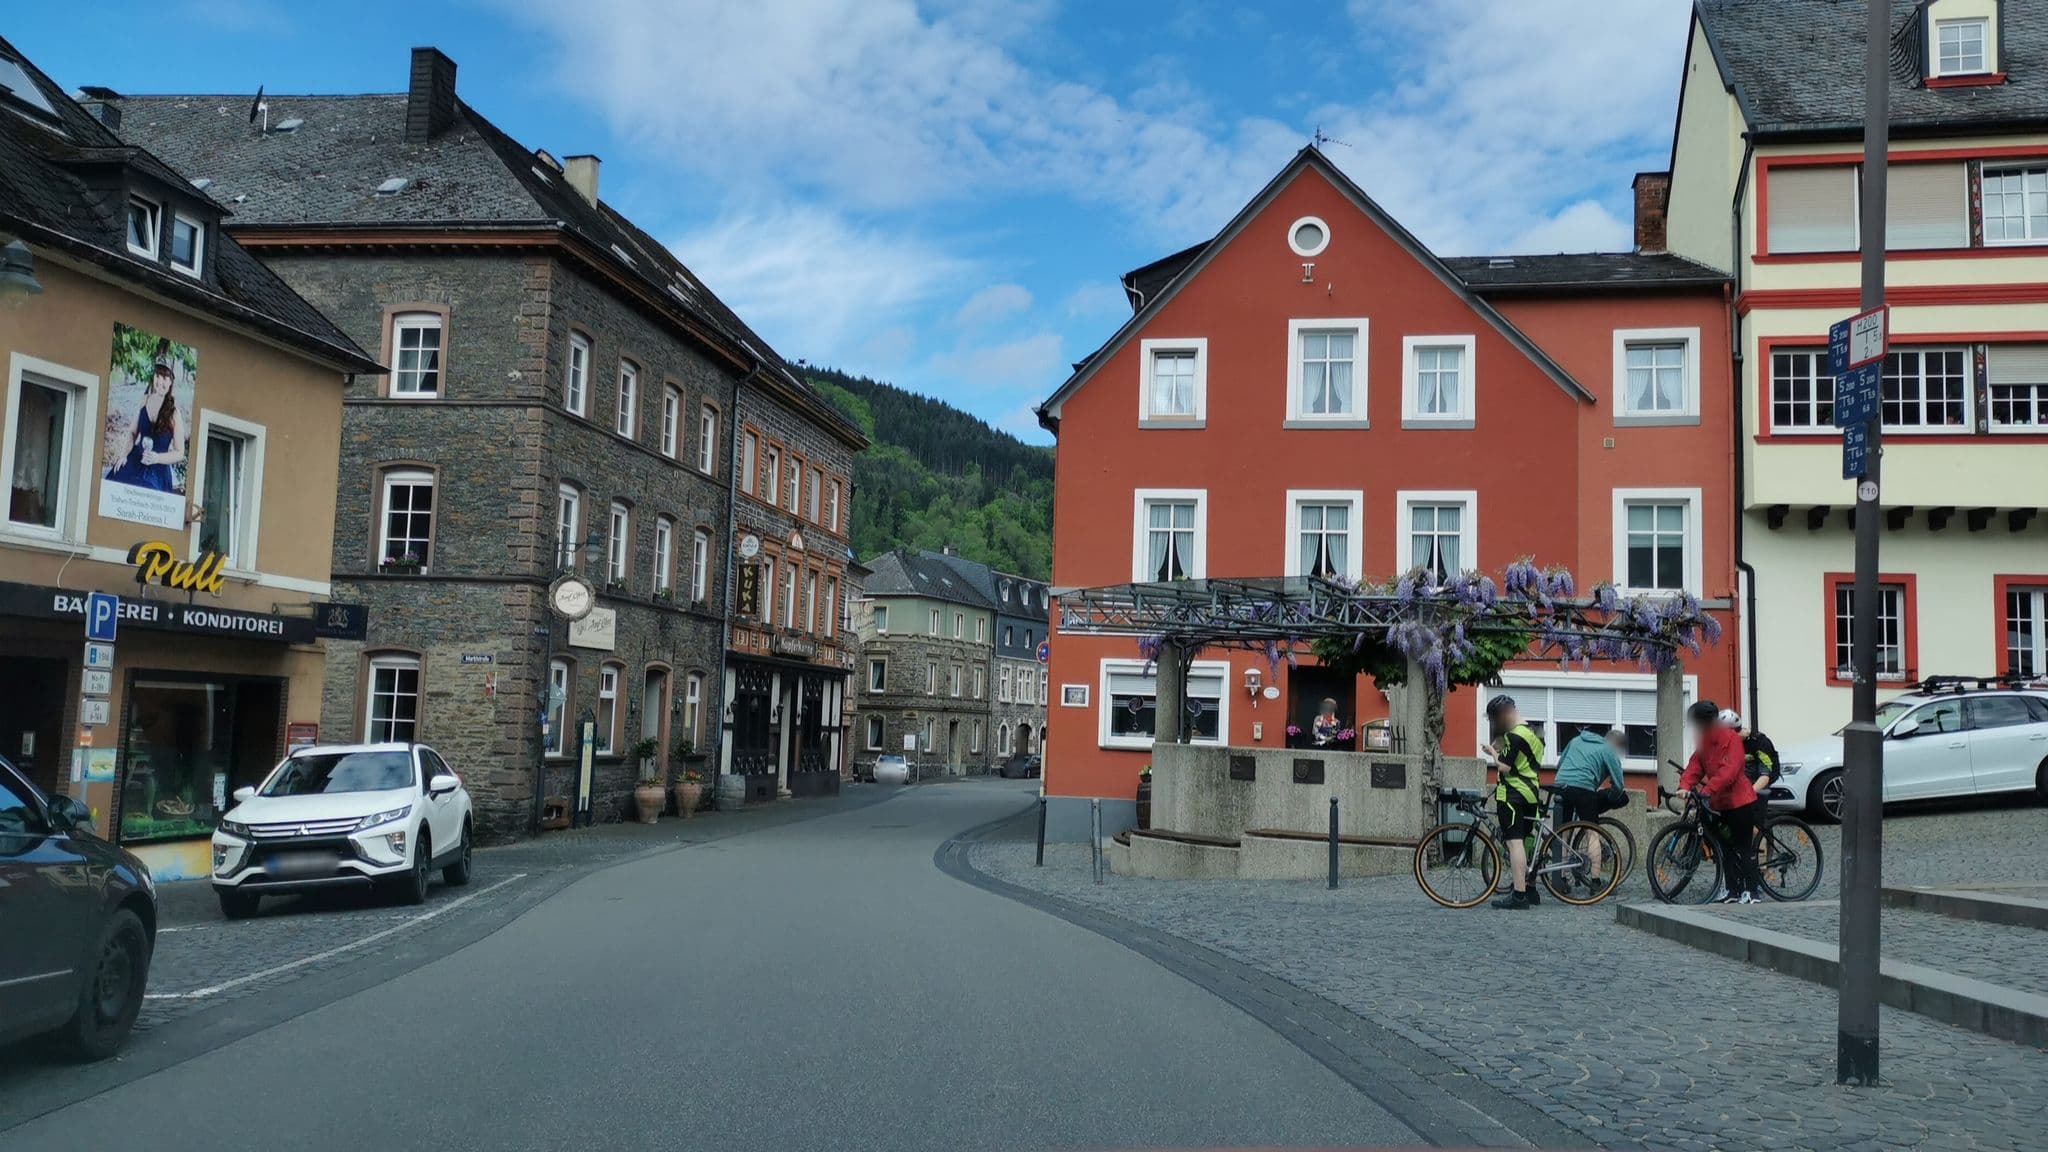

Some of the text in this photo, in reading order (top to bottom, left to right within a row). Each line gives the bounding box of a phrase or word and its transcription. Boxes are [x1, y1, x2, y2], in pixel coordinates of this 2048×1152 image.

[1856, 313, 1878, 331] H200
[1860, 487, 1877, 496] T10
[134, 541, 227, 593] Pull
[741, 566, 754, 613] KUKA
[53, 595, 284, 635] BÄEREI KONDITOREI
[95, 599, 111, 634] P
